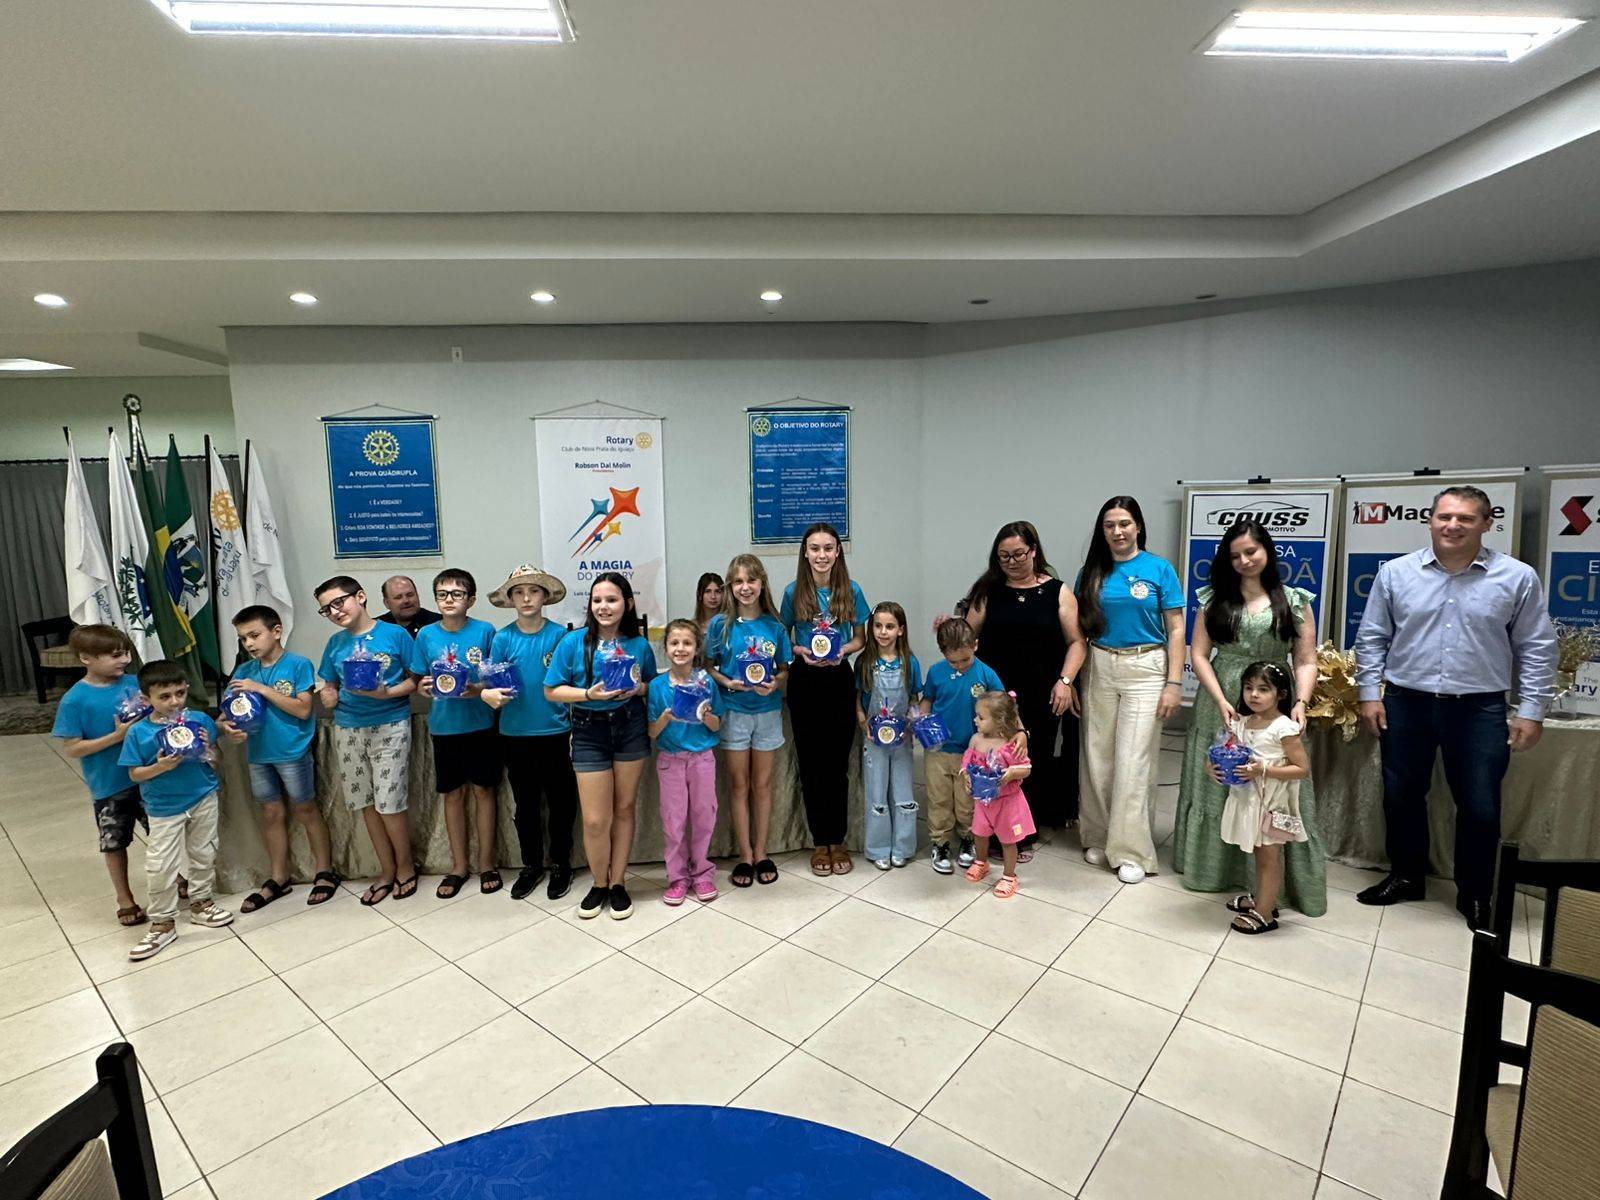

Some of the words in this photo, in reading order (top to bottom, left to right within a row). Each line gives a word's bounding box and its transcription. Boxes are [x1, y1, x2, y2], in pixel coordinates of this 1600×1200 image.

[606, 436, 634, 445] Rotary
[579, 561, 588, 570] A
[591, 560, 632, 570] MAGIA
[577, 572, 592, 580] DO
